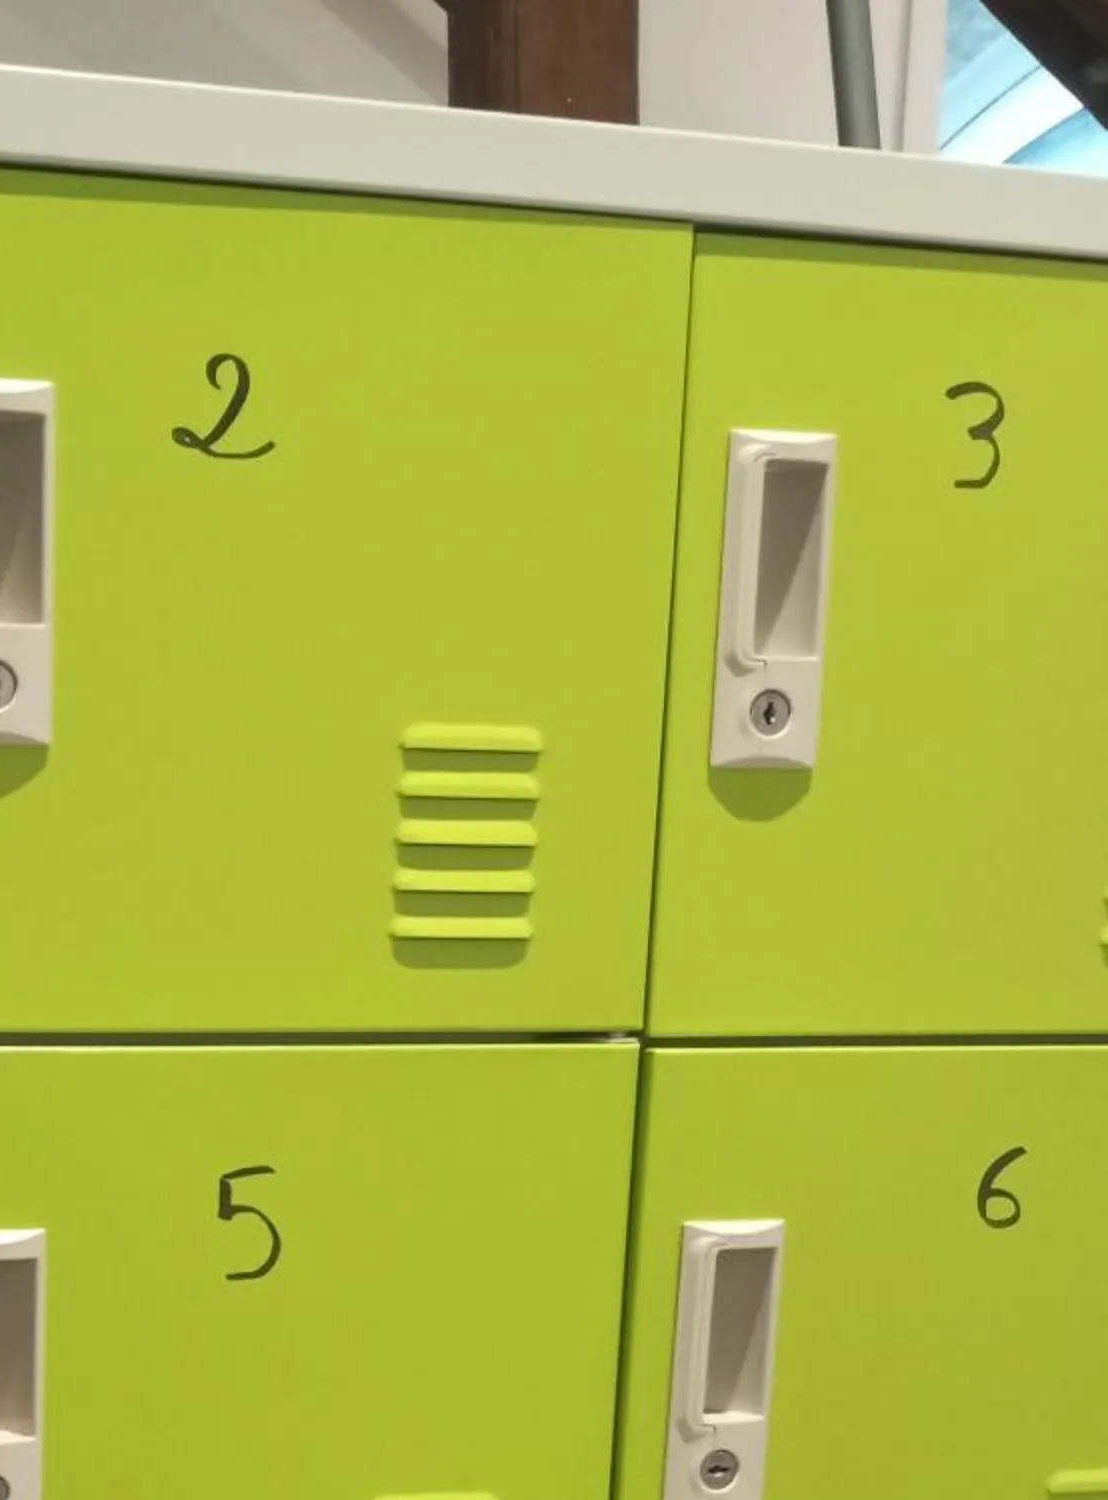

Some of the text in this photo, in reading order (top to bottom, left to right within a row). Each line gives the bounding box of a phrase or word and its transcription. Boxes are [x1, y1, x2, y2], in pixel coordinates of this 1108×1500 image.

[171, 353, 276, 460] 2
[945, 381, 1005, 489] 3
[217, 1165, 282, 1281] 5
[977, 1146, 1027, 1229] 6
